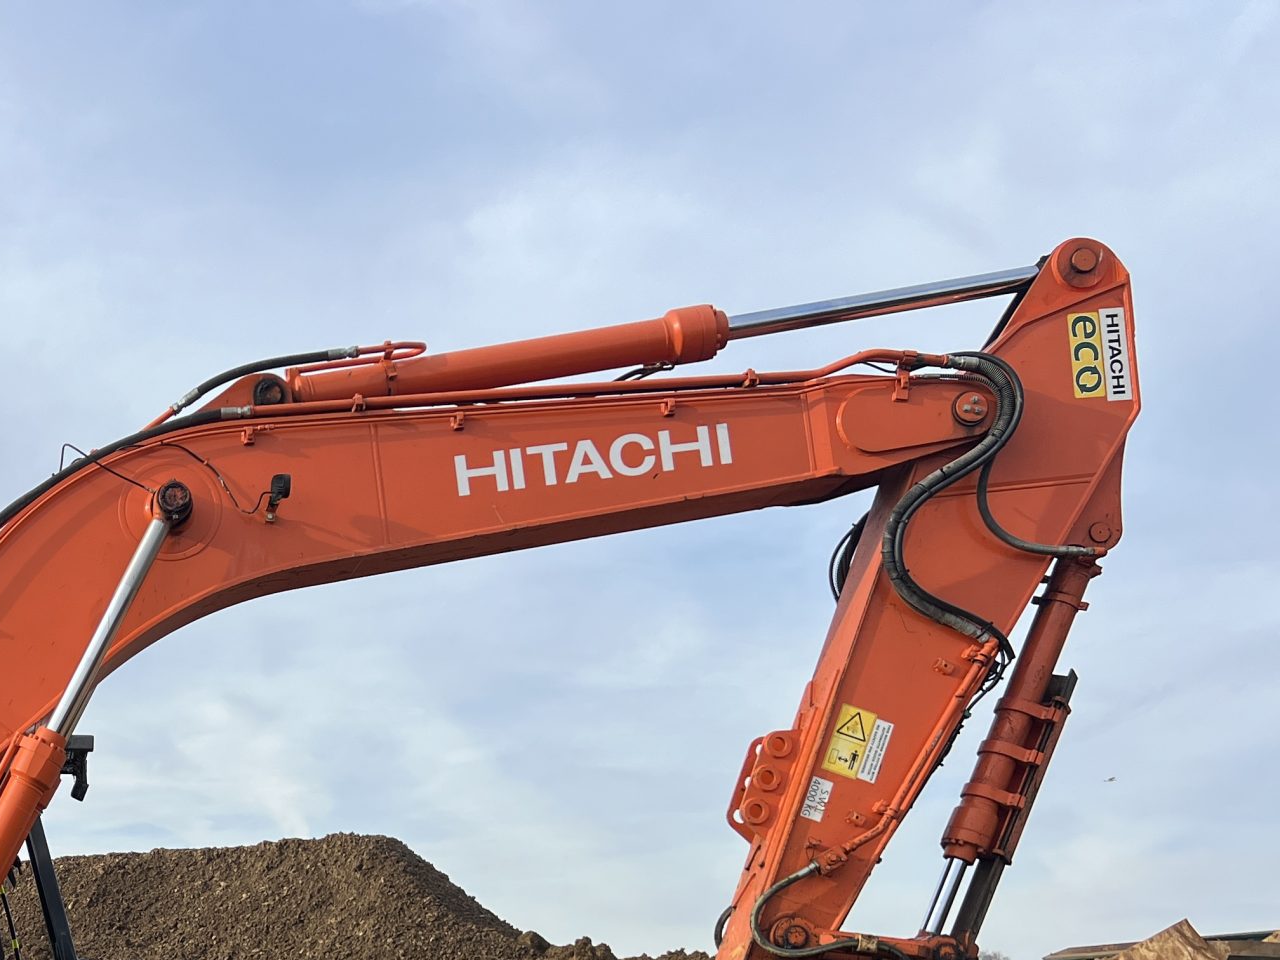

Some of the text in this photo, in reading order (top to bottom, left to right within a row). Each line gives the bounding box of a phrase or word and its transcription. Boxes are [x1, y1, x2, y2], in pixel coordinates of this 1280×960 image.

[1071, 315, 1102, 394] eco
[1105, 313, 1126, 395] HITACHI
[453, 423, 733, 497] HITACHI
[807, 778, 821, 802] 4000
